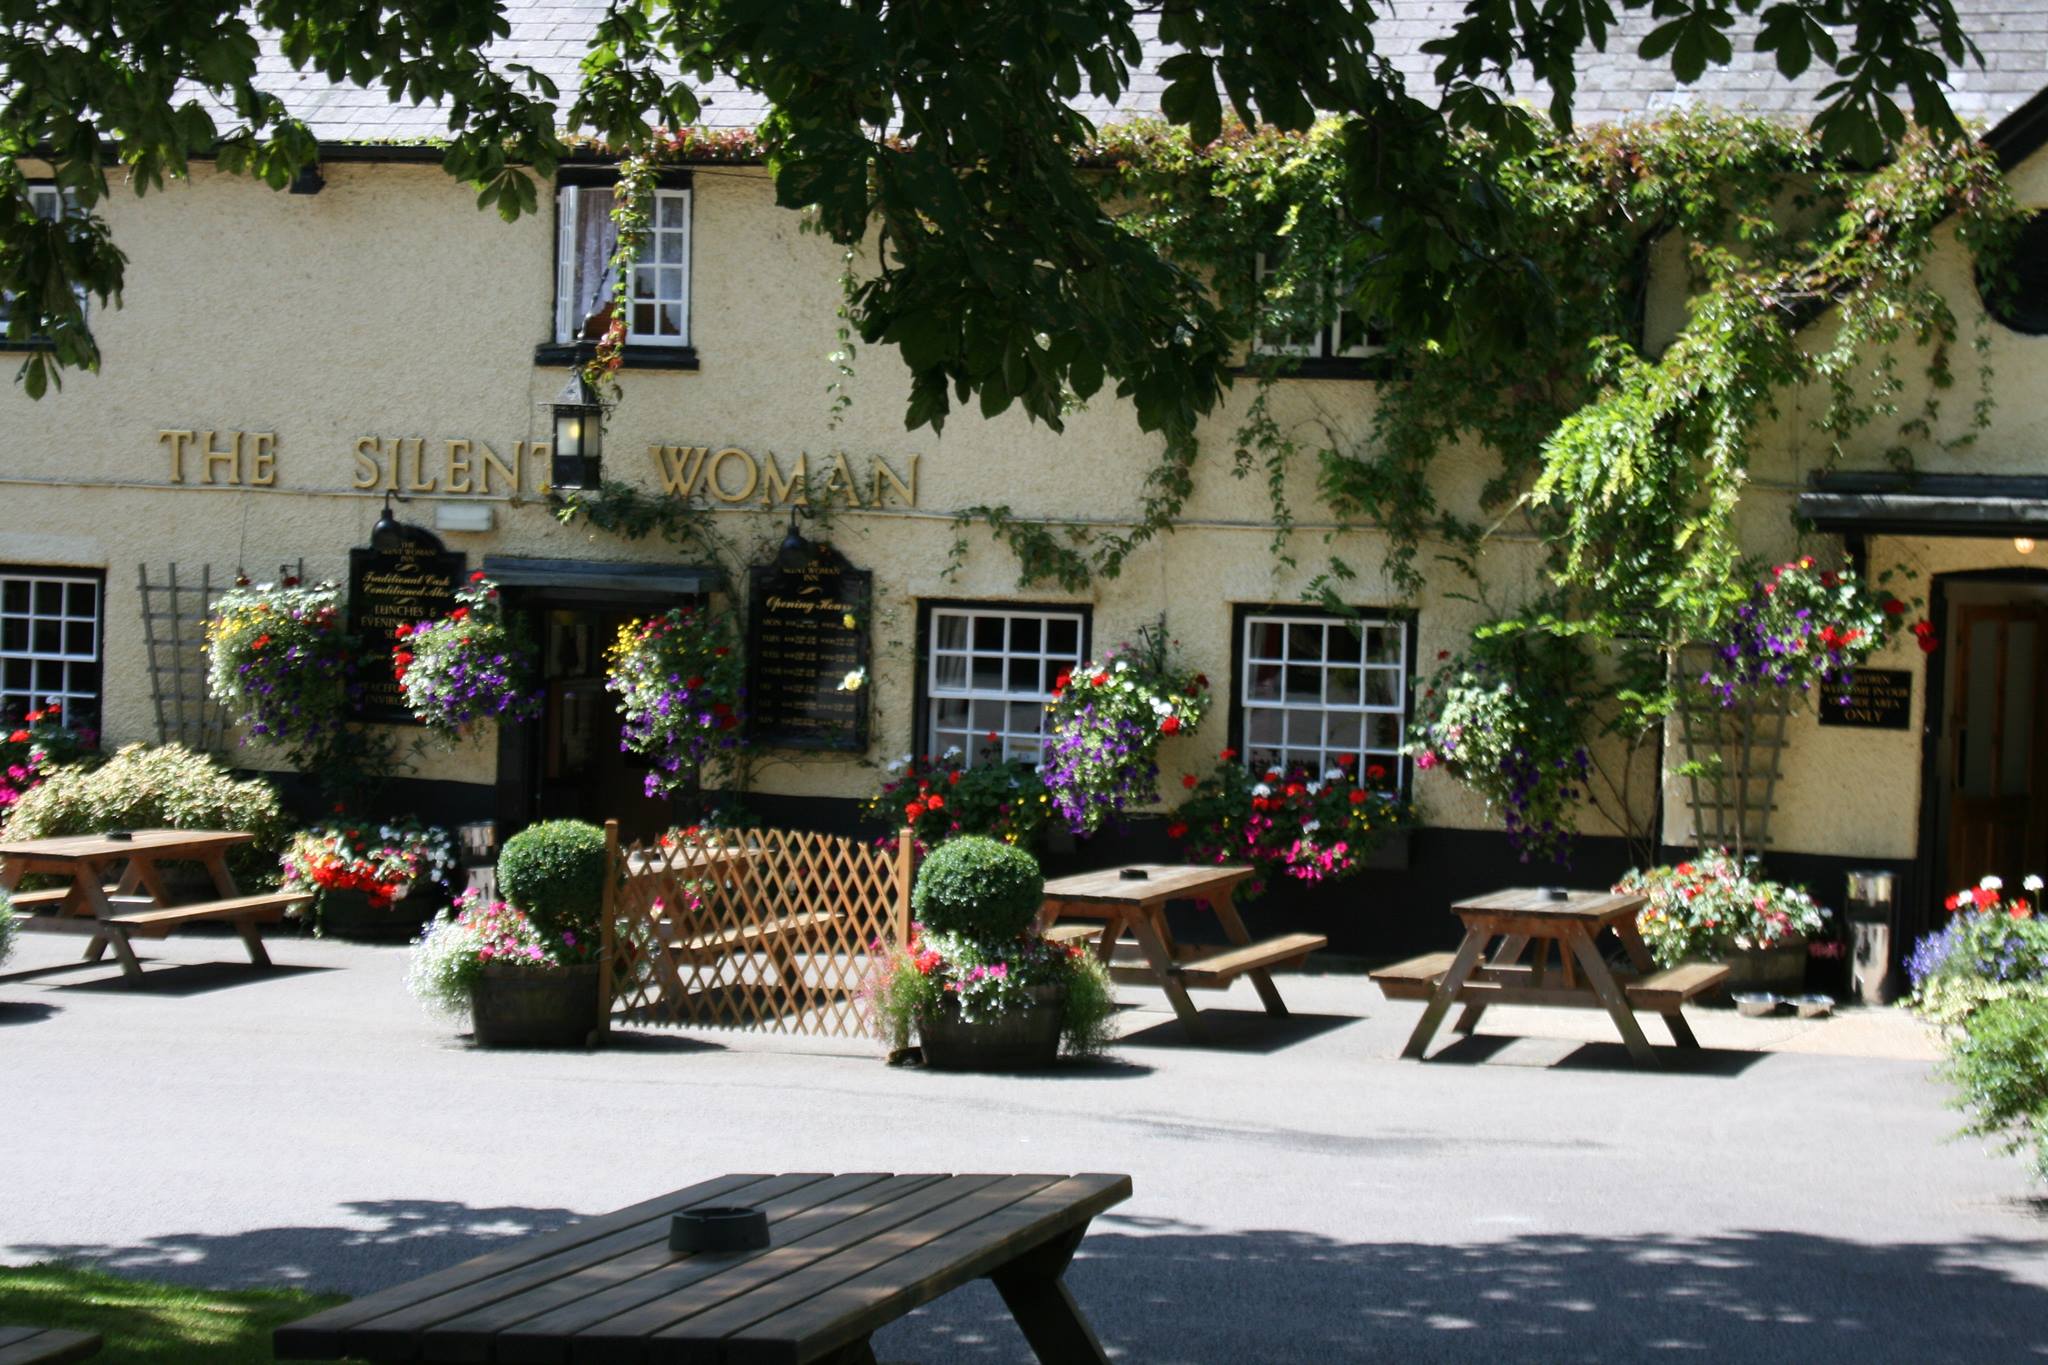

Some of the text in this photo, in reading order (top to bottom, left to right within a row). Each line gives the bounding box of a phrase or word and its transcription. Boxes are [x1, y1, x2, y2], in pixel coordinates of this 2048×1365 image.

[158, 429, 278, 486] THE
[648, 444, 920, 508] WOMAN
[361, 571, 422, 585] Traditional
[375, 605, 424, 617] LUNCHES
[766, 596, 815, 614] Opening
[1844, 709, 1884, 723] ONLY
